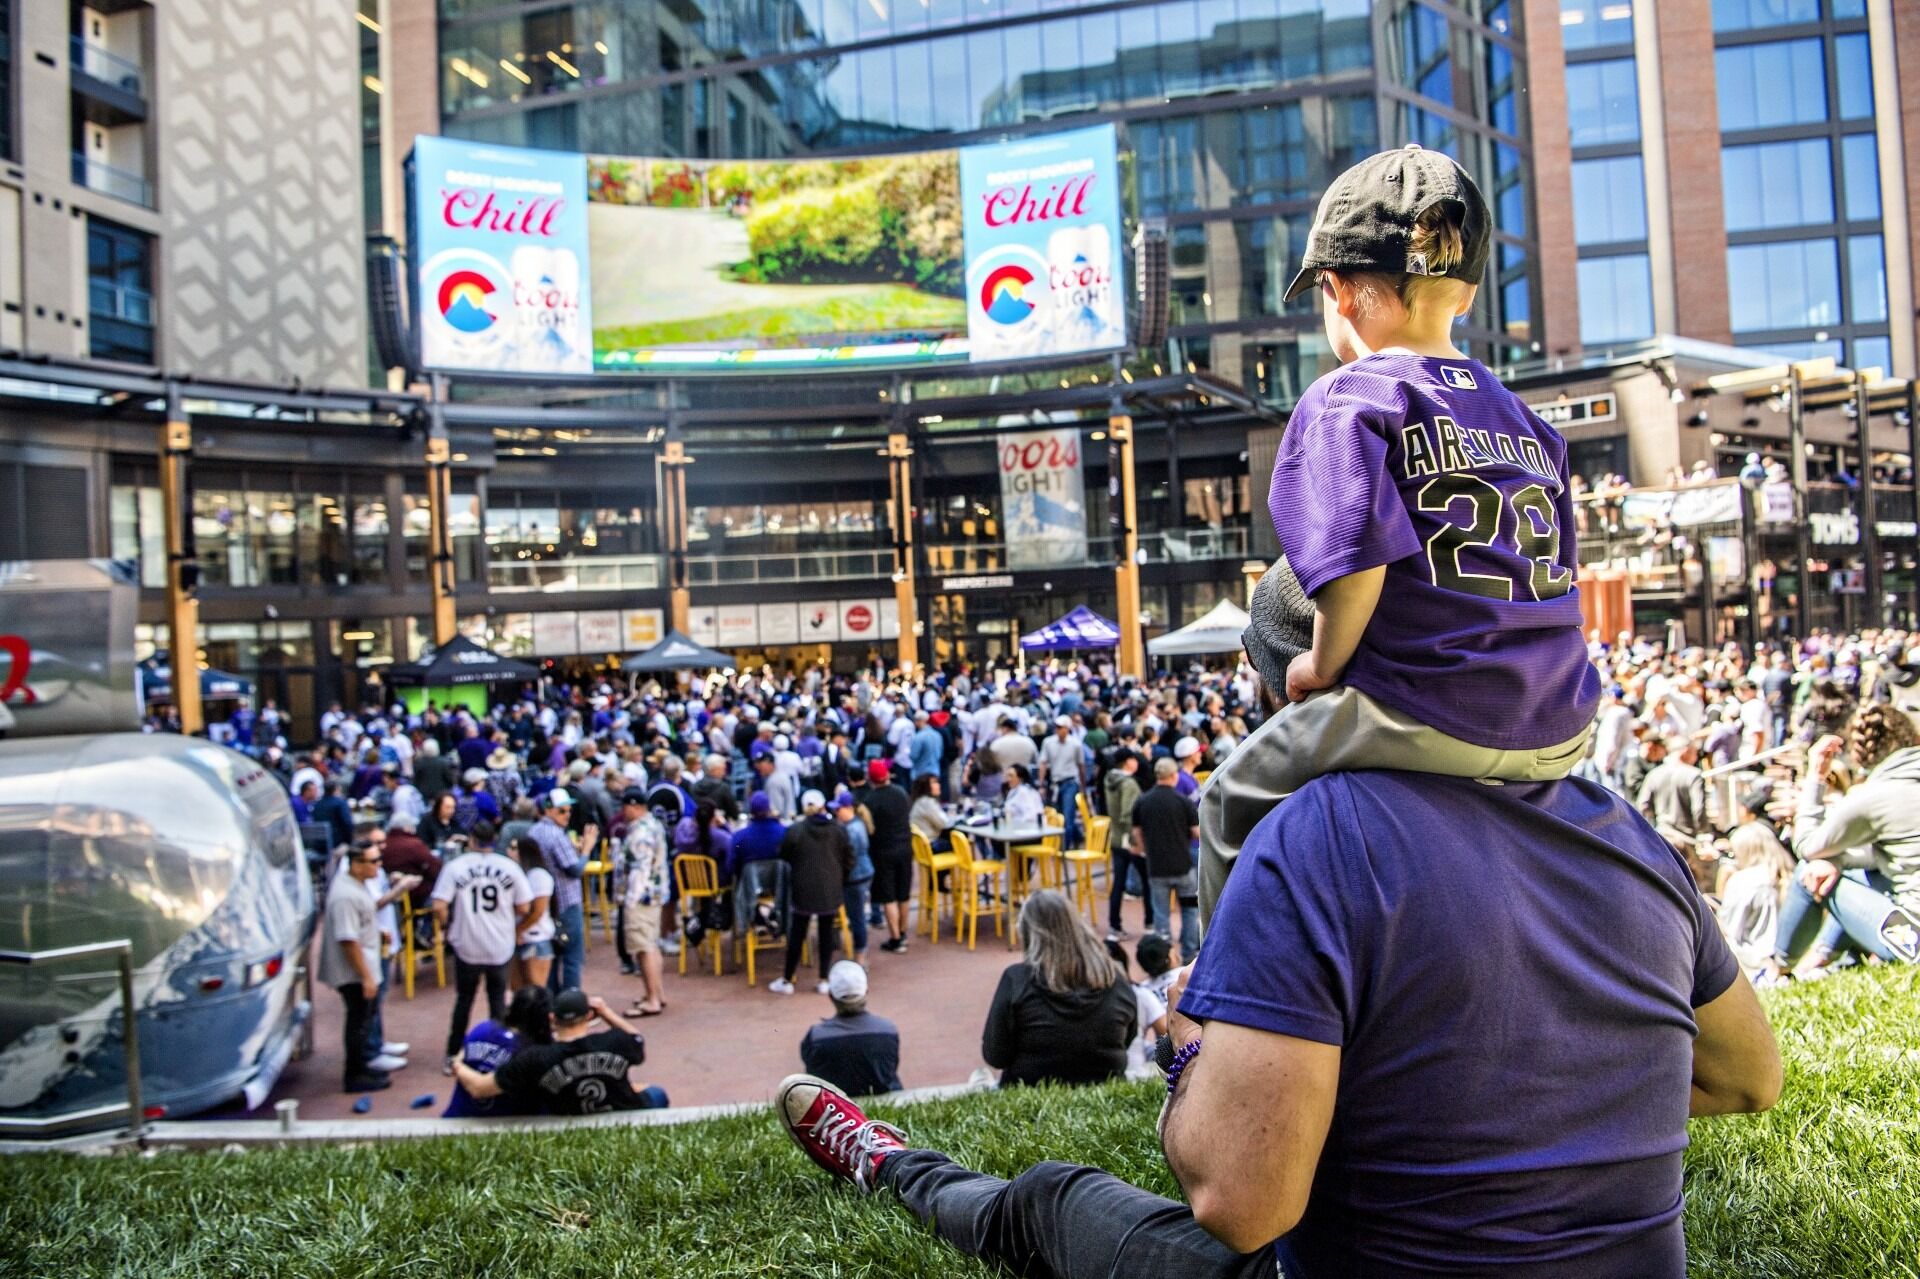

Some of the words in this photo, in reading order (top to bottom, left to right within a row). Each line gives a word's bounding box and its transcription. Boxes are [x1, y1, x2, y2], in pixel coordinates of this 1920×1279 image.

[441, 188, 565, 238] Chill
[982, 173, 1096, 227] Chill
[1000, 434, 1078, 472] oors
[1418, 473, 1572, 602] 28
[471, 884, 498, 913] 19
[576, 1076, 614, 1114] 2
